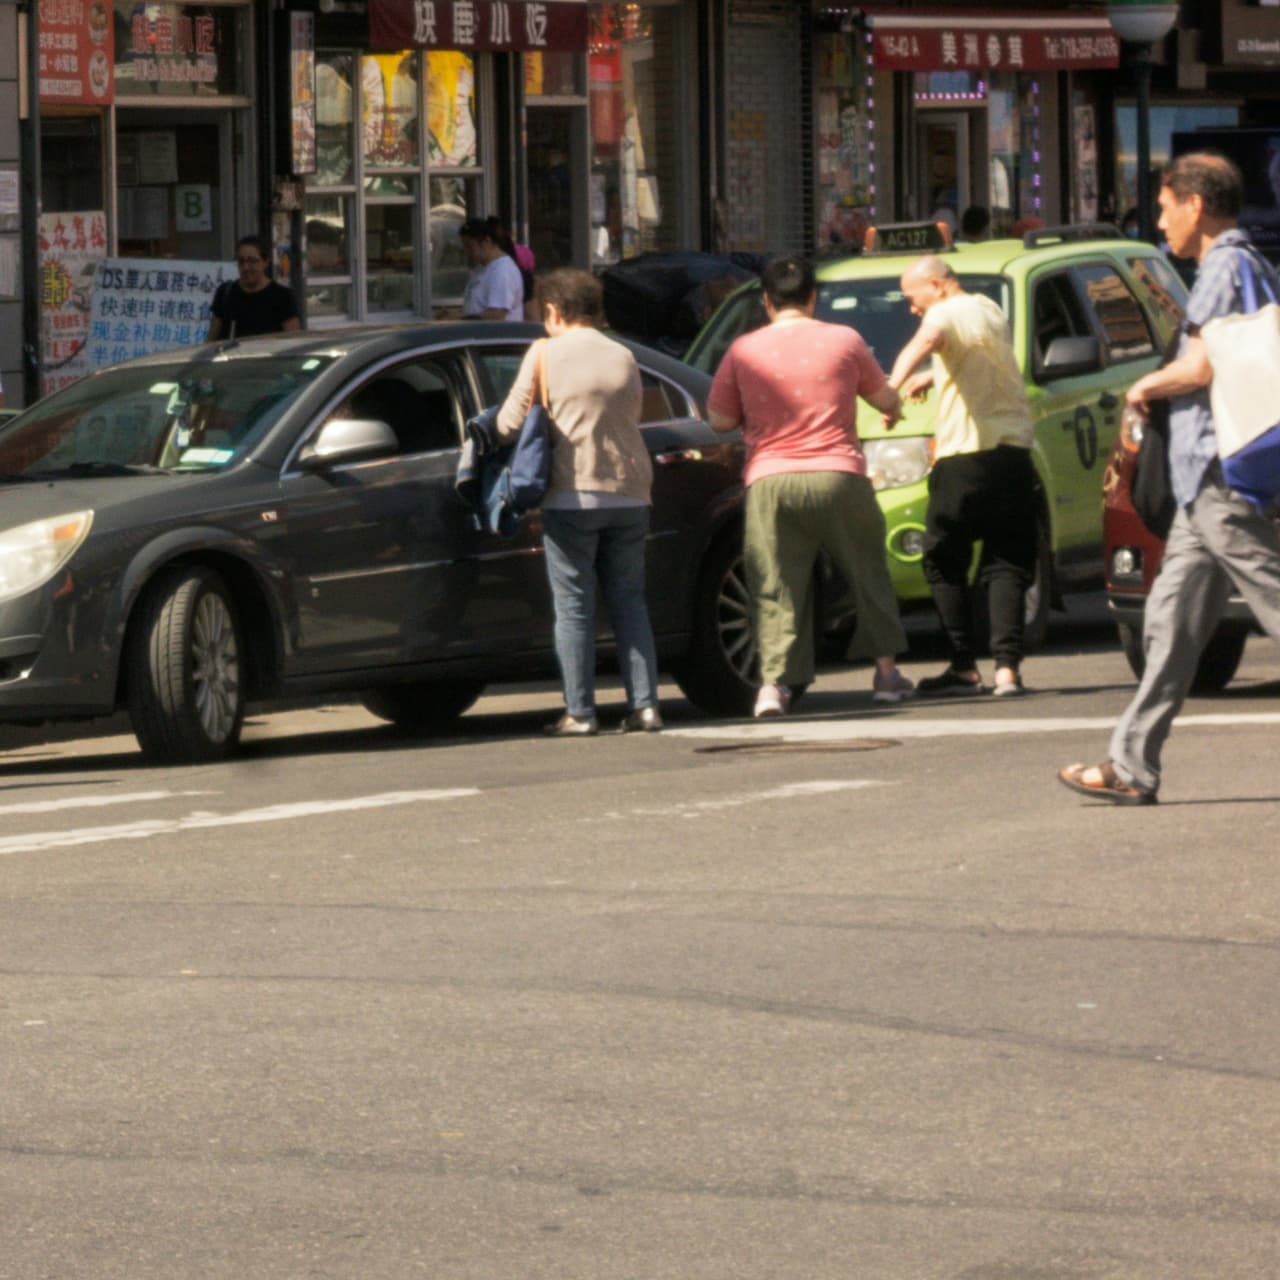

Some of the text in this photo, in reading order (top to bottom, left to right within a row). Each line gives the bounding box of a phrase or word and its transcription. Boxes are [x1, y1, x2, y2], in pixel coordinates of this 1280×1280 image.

[413, 0, 548, 47] 快鹿小吃
[183, 188, 203, 218] B
